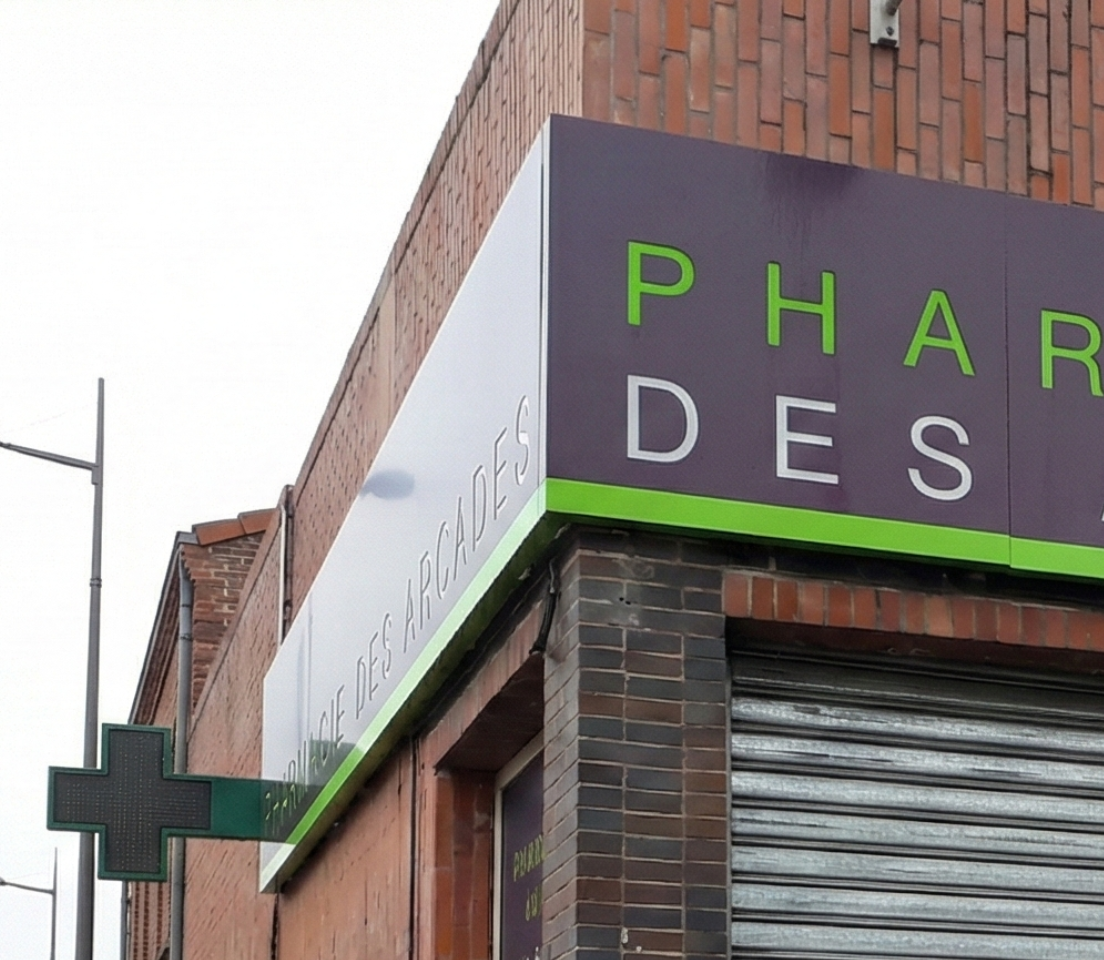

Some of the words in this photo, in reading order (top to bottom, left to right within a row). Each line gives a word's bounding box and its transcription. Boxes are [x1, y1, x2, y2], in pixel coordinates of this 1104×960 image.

[626, 374, 974, 501] DES
[355, 612, 392, 720] DES
[404, 395, 530, 654] ARCADES
